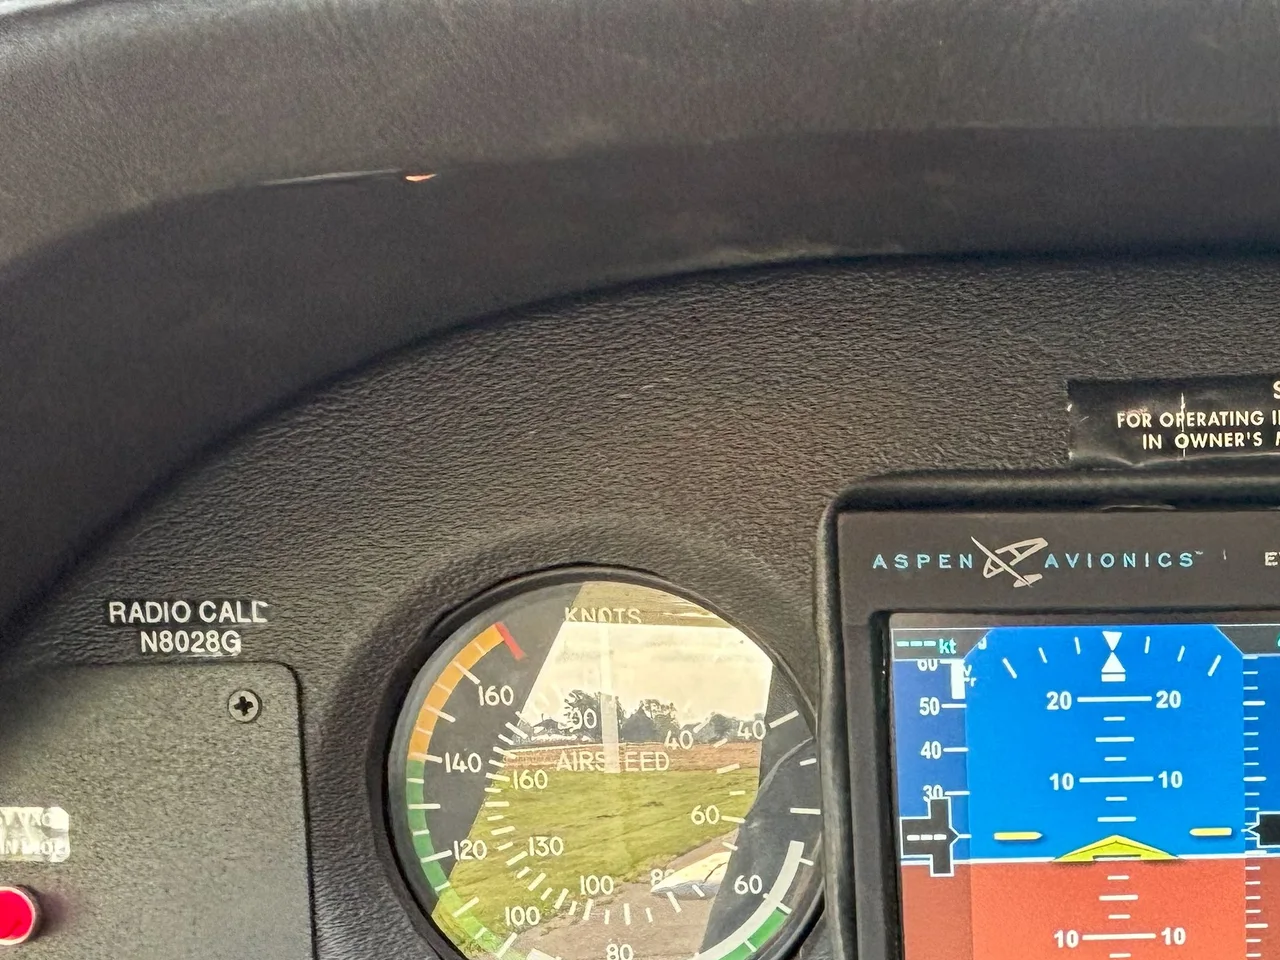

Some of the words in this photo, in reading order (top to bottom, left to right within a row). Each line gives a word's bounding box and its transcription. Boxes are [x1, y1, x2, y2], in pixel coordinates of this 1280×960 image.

[1116, 412, 1152, 428] FOR
[1159, 410, 1265, 428] OPERATING
[1142, 433, 1162, 450] IN
[1174, 432, 1263, 449] OWNER'S
[872, 552, 974, 570] ASPEN
[1043, 550, 1197, 569] AVIONICS
[109, 601, 192, 624] RADIO
[198, 600, 265, 623] CALL
[564, 607, 642, 625] KNOTS
[140, 631, 242, 654] N8028G
[478, 685, 514, 707] 160
[1047, 691, 1073, 710] 20
[1156, 690, 1182, 709] 20
[919, 697, 940, 716] 50
[444, 753, 483, 774] 140
[556, 750, 670, 771] AIRSEED
